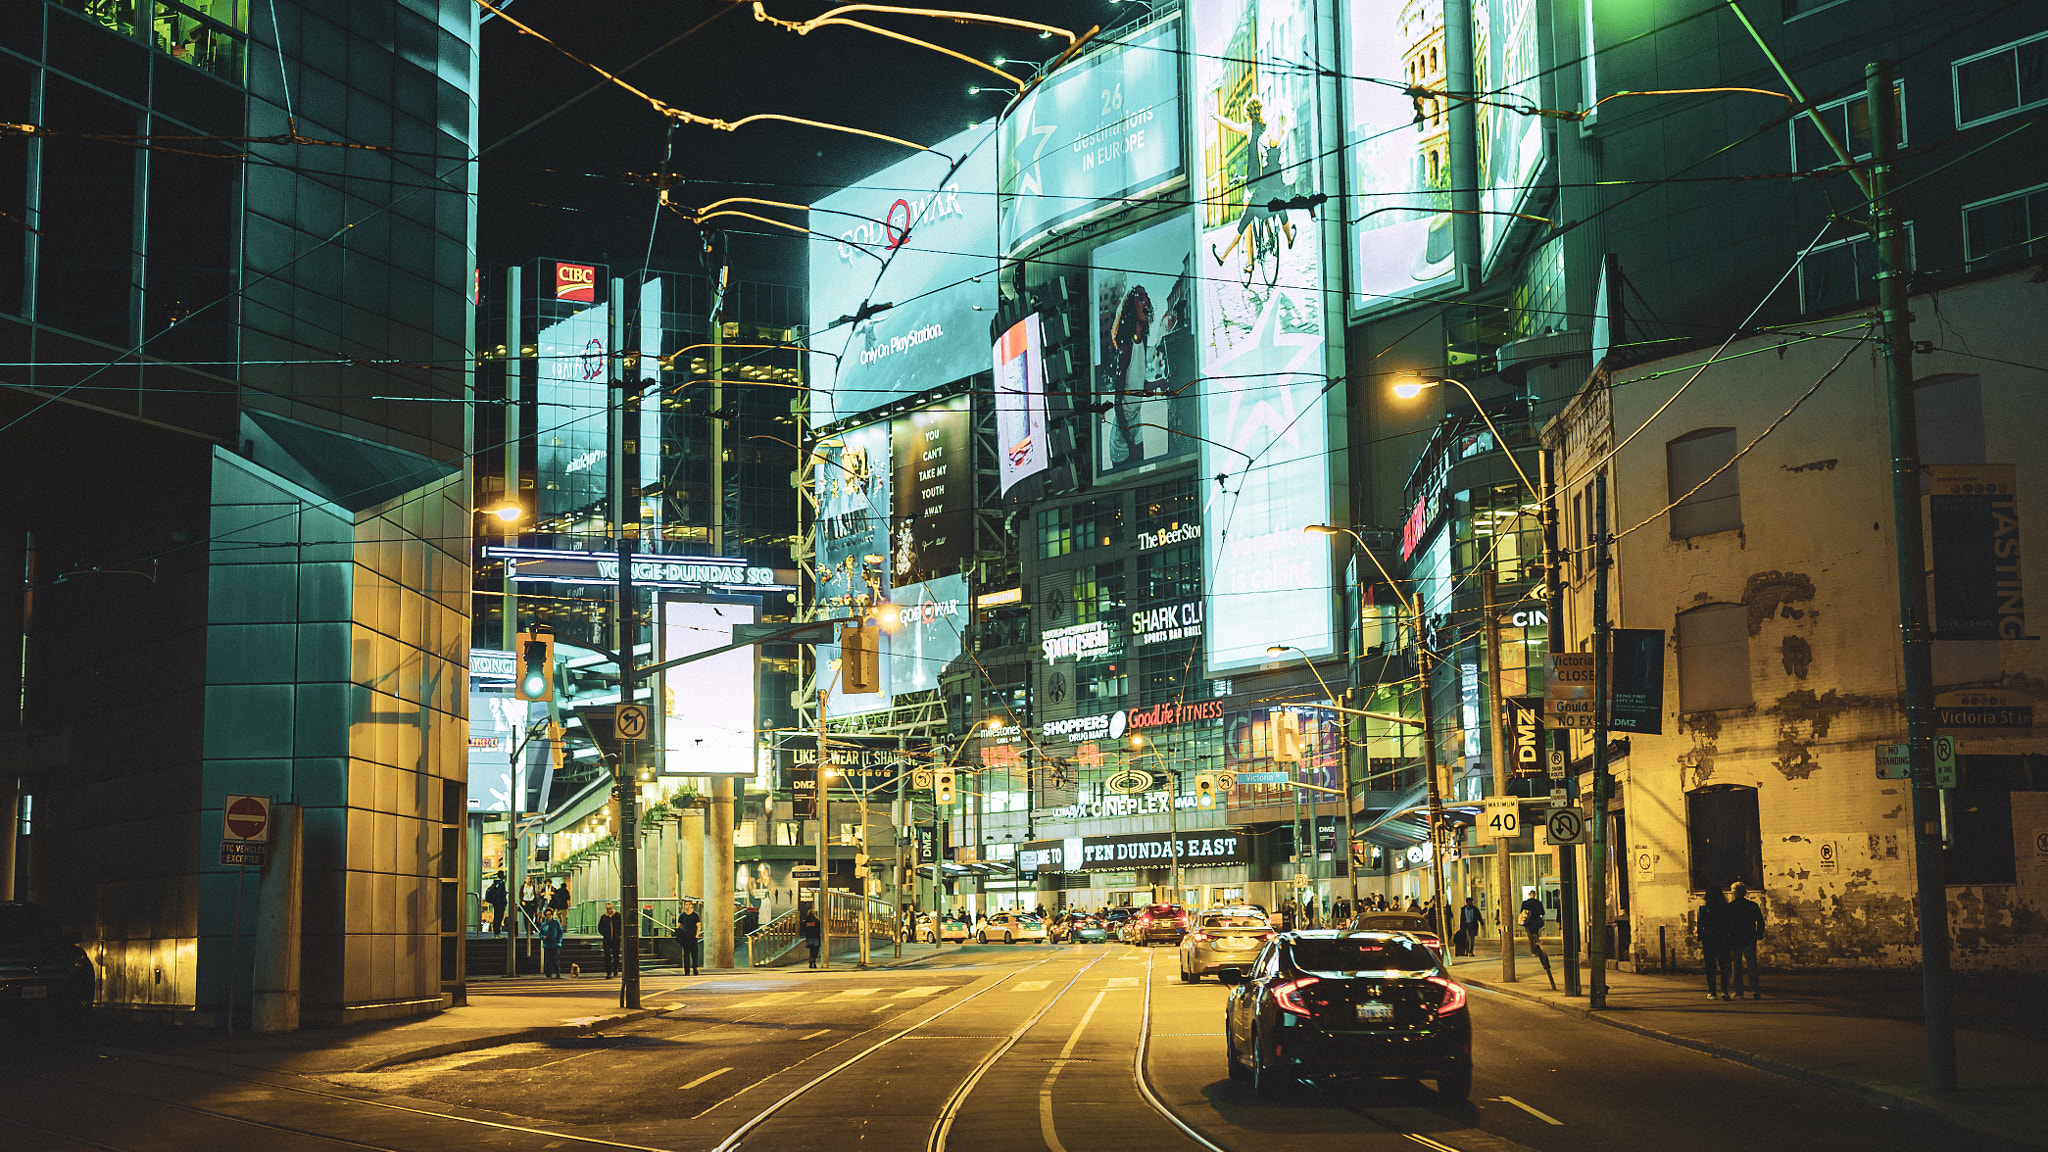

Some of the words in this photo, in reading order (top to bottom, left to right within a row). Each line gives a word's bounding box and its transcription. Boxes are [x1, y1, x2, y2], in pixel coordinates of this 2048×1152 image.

[1101, 83, 1123, 117] 26
[1073, 105, 1153, 153] destinations
[1082, 152, 1095, 172] IN
[1098, 130, 1145, 165] EUROPE
[839, 217, 884, 260] GOD
[910, 182, 963, 228] WAR
[558, 266, 593, 284] CIBC
[860, 346, 878, 365] Only
[925, 429, 940, 442] YOU
[923, 447, 942, 462] CAN'T
[919, 468, 935, 482] TAKE
[937, 464, 947, 477] MY
[922, 485, 945, 500] YOUTH
[924, 504, 943, 517] AWAY
[598, 561, 745, 584] YONGE-DUNDAS
[747, 567, 774, 584] SQ
[1132, 605, 1179, 634] SHARK
[1552, 655, 1594, 667] Victoria
[1558, 670, 1594, 681] CLOSE
[1557, 701, 1588, 712] Gould
[1558, 716, 1576, 727] NO
[1614, 718, 1638, 727] DMZ
[1940, 710, 1996, 724] Victoria
[2001, 711, 2013, 724] St
[2018, 712, 2031, 724] Ln
[1043, 714, 1109, 736] SHOPPERS
[1068, 731, 1089, 743] DRUG
[1089, 728, 1109, 741] MART
[1517, 708, 1537, 763] DMZ
[793, 749, 816, 764] LIKE
[830, 750, 859, 765] WEAR
[1888, 746, 1899, 755] NO
[1877, 756, 1910, 766] STANDING
[793, 780, 816, 790] DMZ
[1245, 773, 1274, 782] Victoria
[1091, 796, 1170, 818] CINEPLEX
[1489, 813, 1517, 831] 40
[235, 844, 266, 854] VEHICLES
[922, 831, 932, 857] DMZ
[1050, 847, 1062, 864] TO
[1084, 844, 1114, 862] TEN
[1116, 839, 1185, 861] DUNDAS
[1187, 837, 1238, 857] EAST
[226, 854, 260, 864] EXCEPTED
